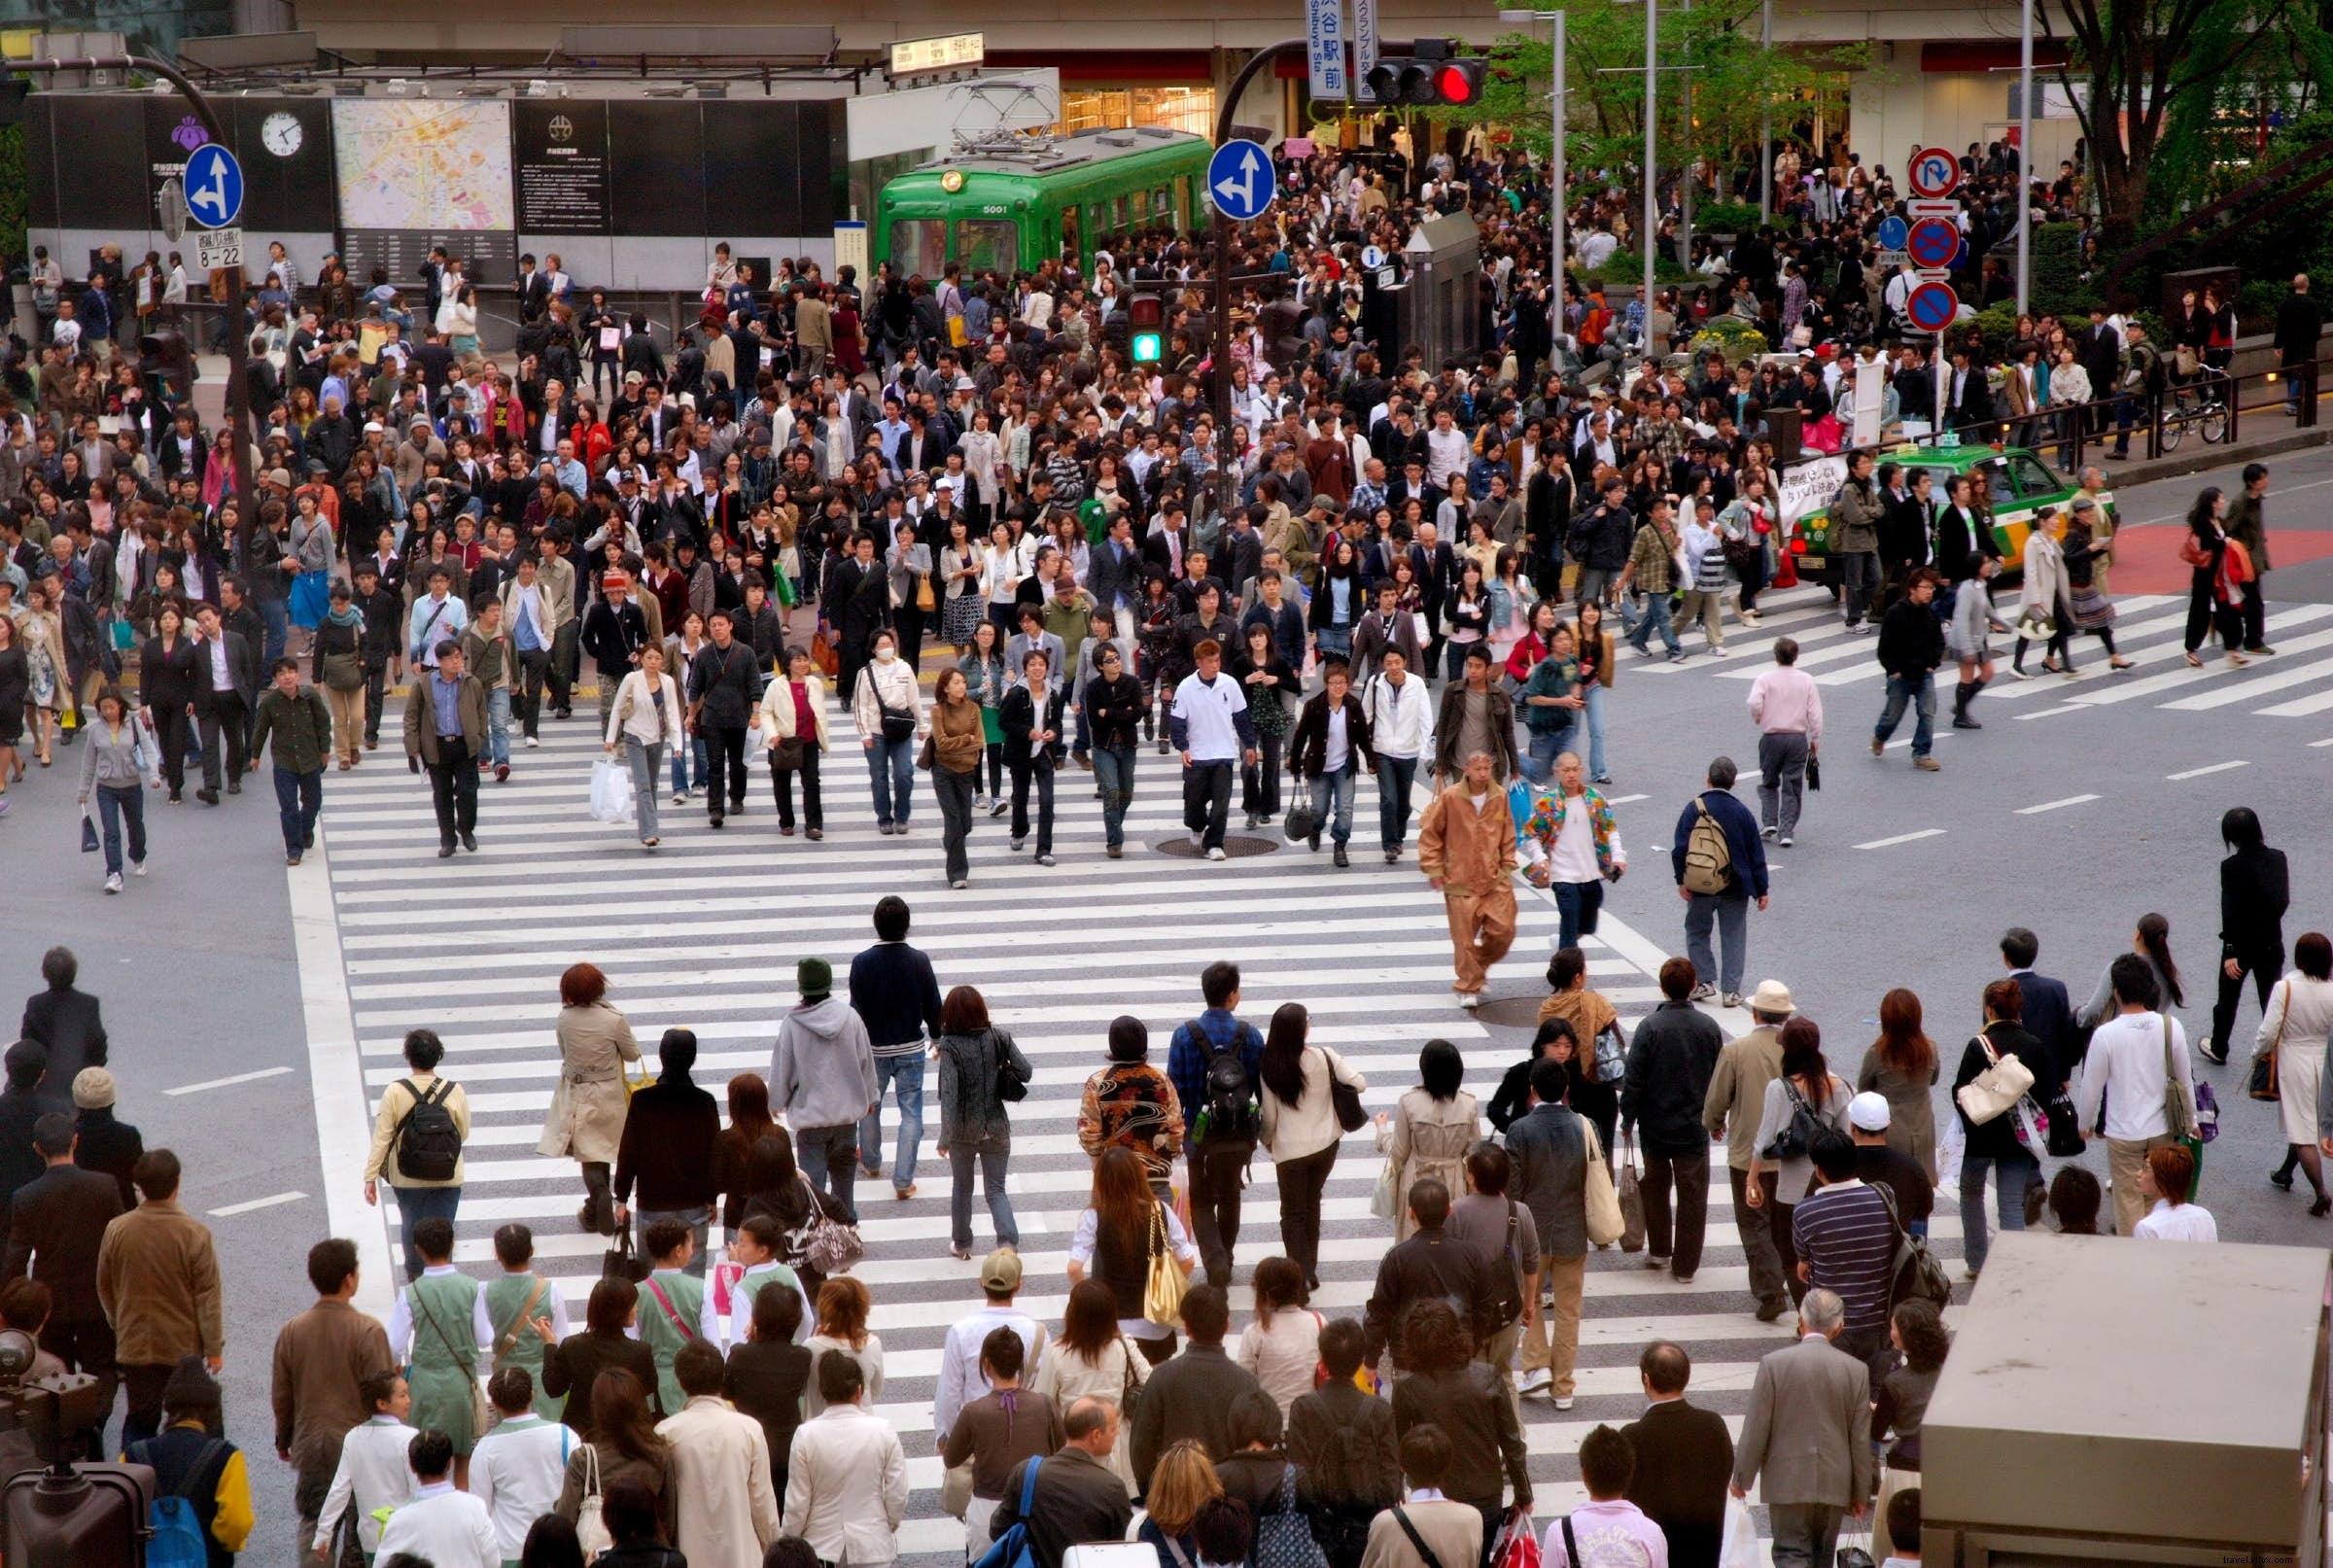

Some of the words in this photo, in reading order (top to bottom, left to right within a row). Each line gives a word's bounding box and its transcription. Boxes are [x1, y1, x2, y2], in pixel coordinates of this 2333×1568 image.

[1321, 0, 1341, 89] 谷駅前
[983, 205, 1007, 214] 5001
